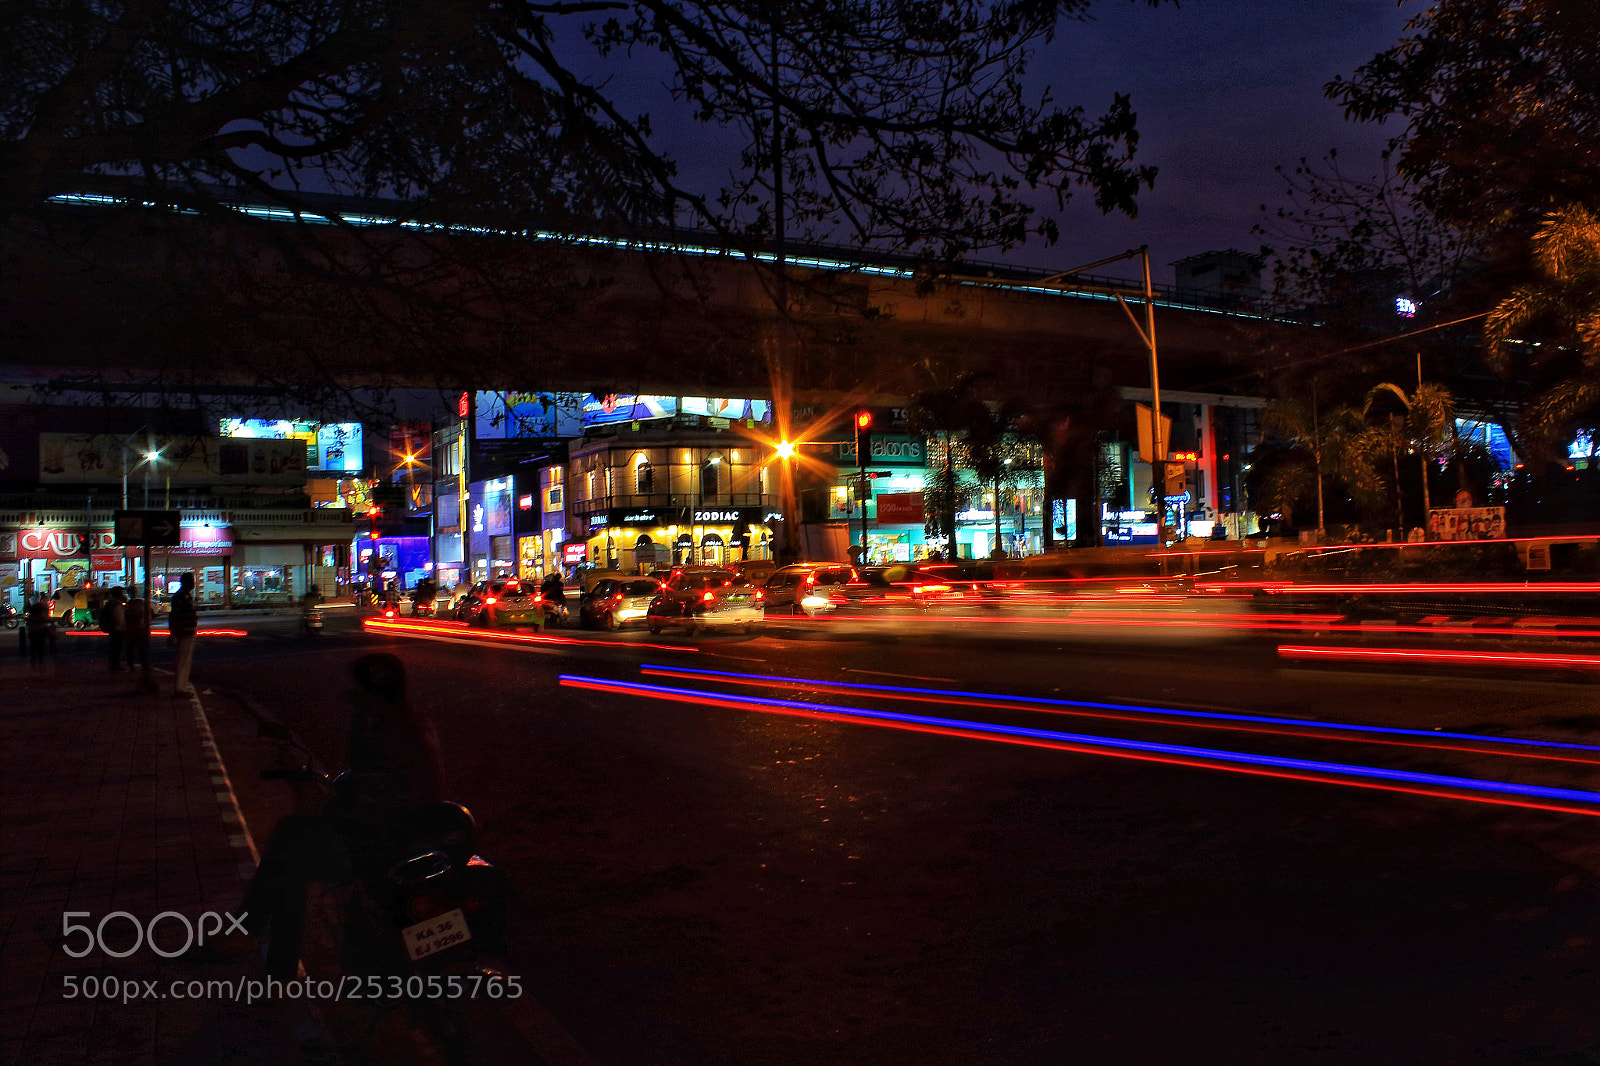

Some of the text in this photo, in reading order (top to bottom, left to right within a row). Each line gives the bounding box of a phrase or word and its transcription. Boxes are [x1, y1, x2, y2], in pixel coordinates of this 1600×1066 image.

[694, 511, 739, 521] ZODIAC
[416, 921, 453, 941] KA 36
[415, 943, 431, 956] EJ
